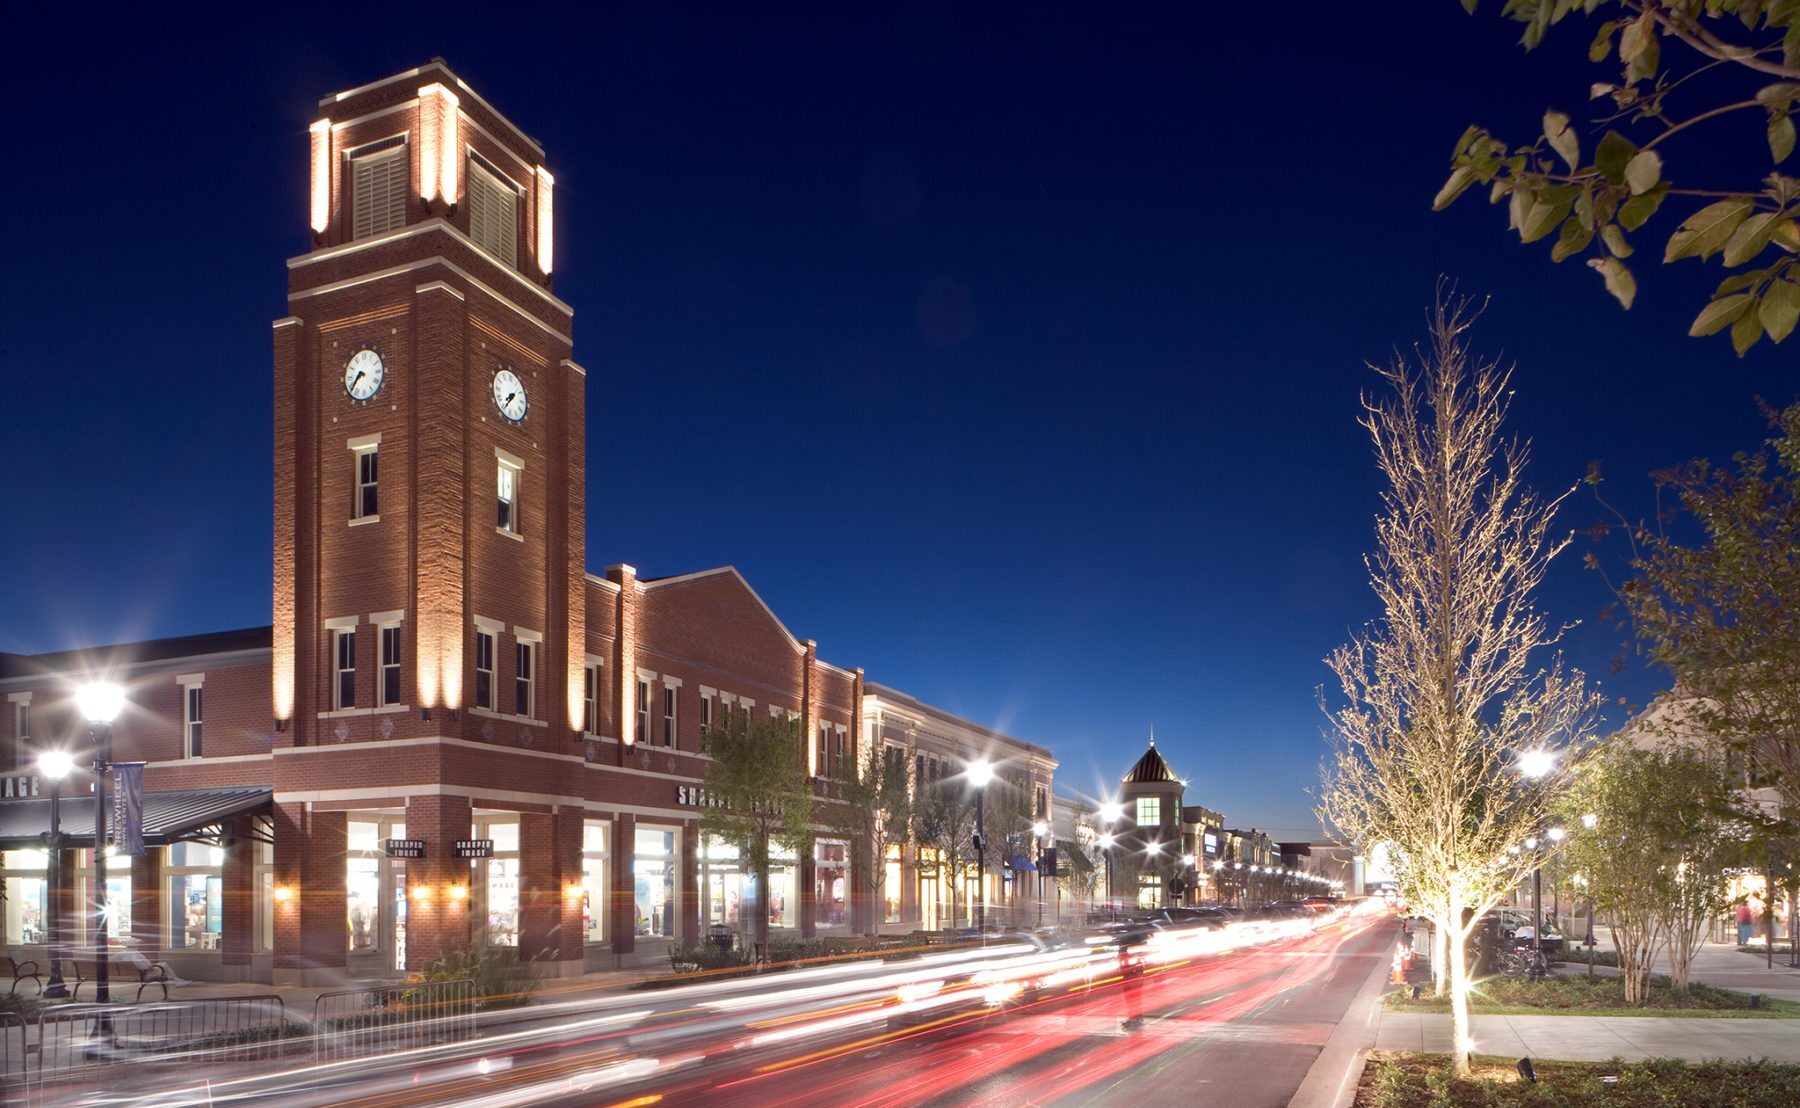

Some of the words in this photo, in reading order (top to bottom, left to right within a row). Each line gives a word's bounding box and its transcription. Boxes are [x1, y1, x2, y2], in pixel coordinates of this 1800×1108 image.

[0, 775, 39, 798] AGE
[389, 840, 423, 849] SHARPER
[456, 841, 491, 849] SHARPER
[394, 849, 418, 857] IMAGE
[461, 849, 486, 857] IMAGE
